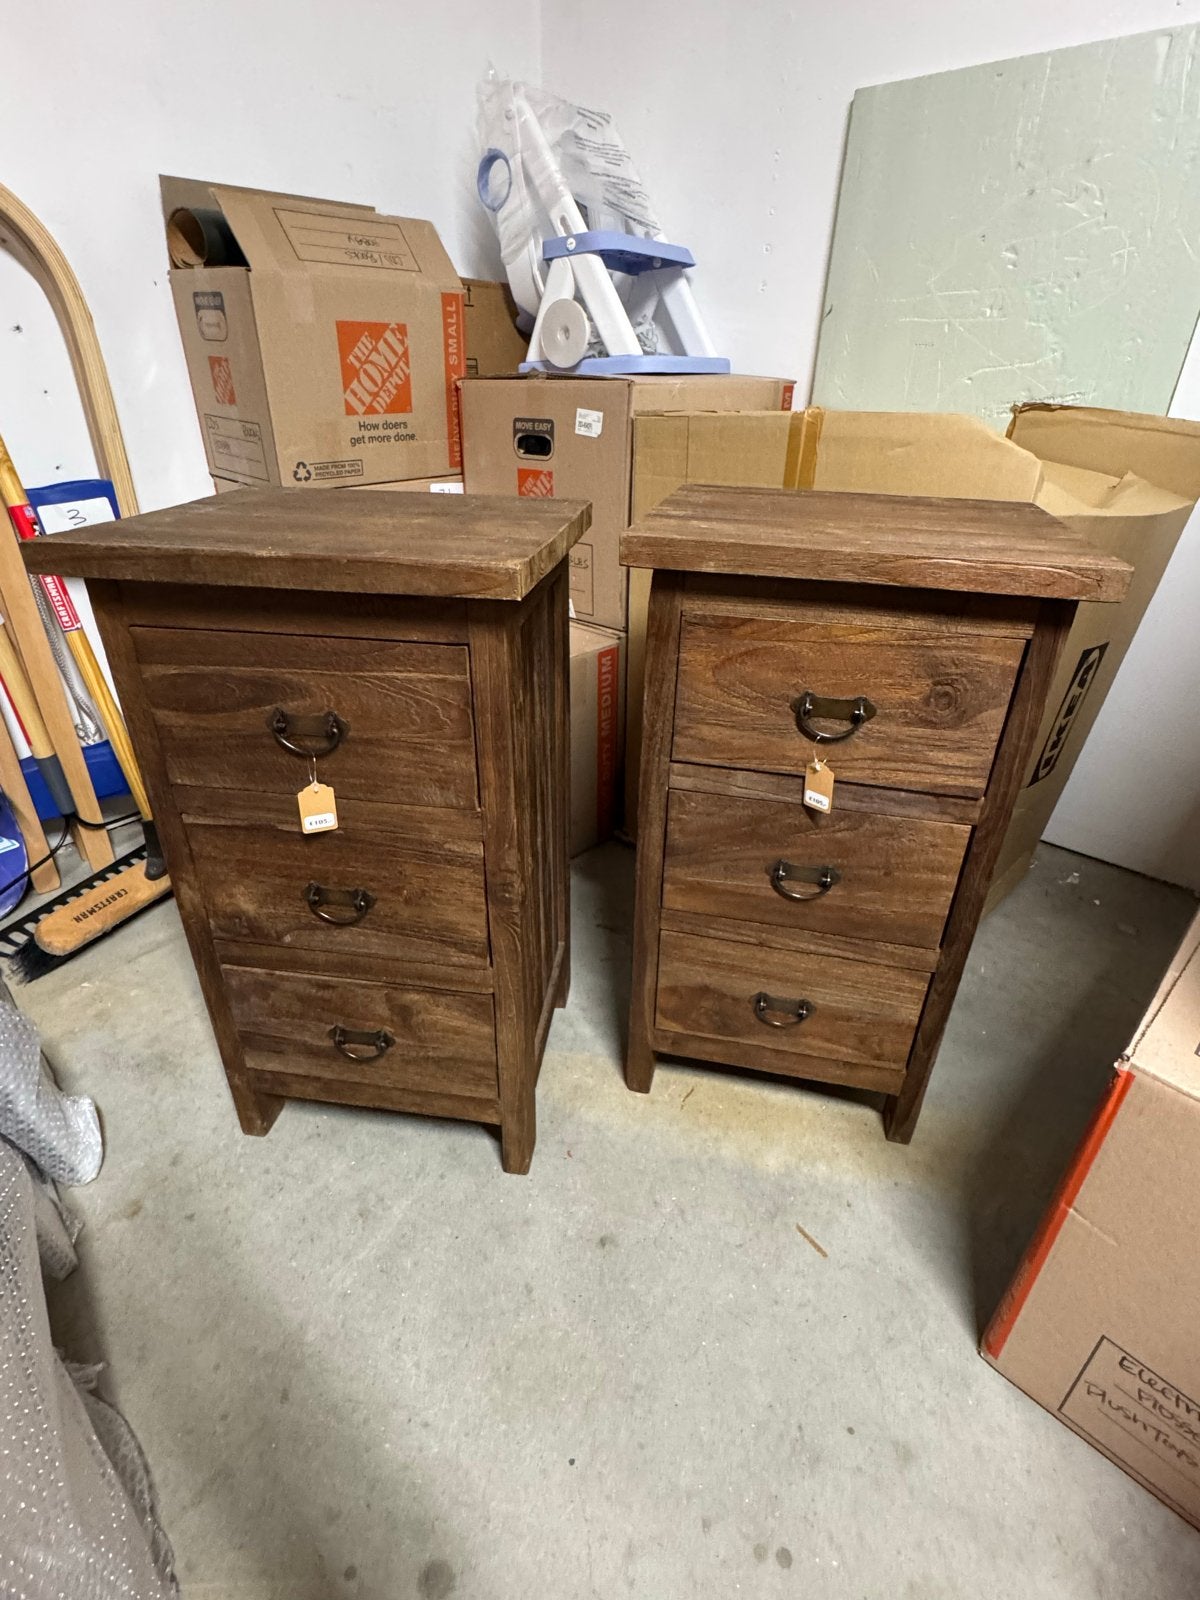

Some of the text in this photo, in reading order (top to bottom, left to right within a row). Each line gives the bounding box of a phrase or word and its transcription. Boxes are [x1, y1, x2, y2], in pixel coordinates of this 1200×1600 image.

[346, 331, 376, 369] THE
[447, 301, 458, 365] SMALL
[344, 322, 409, 416] HOME
[372, 356, 411, 415] DEPOT
[350, 431, 418, 448] get more done.
[358, 420, 408, 432] How doers
[515, 421, 552, 431] MOVE EASY
[66, 508, 88, 526] 3
[601, 656, 612, 737] MEDIUM
[73, 888, 129, 924] CRAFTSMAN
